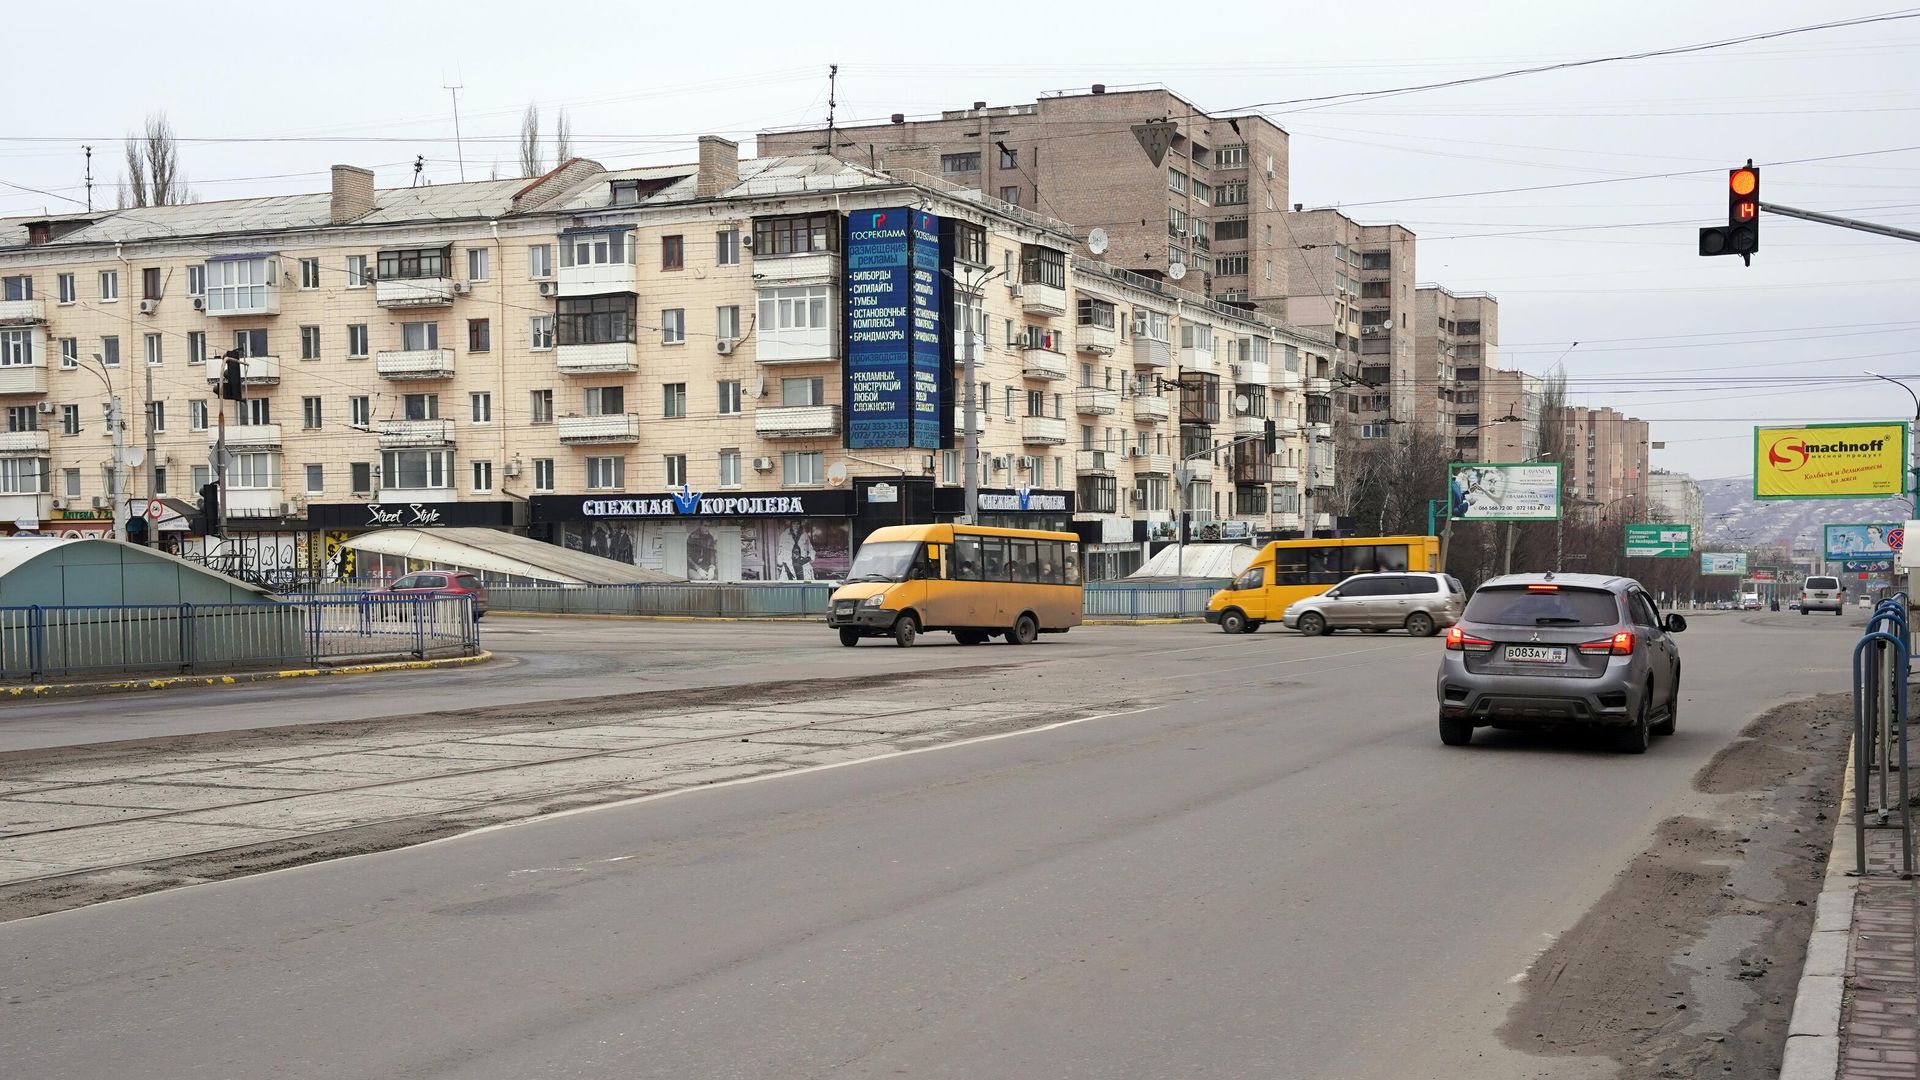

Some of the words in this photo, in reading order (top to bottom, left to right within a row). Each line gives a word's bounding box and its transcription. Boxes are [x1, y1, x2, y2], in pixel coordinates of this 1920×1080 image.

[1741, 203, 1753, 217] 14
[851, 229, 906, 240] ГОСРЕКЛАМА
[849, 243, 906, 258] размещение
[857, 254, 898, 268] рекламы
[853, 270, 891, 281] БИЛБОРДЫ
[853, 282, 893, 294] СИТИЛАЙТЫ
[854, 296, 878, 306] ТУМБЫ
[853, 307, 907, 319] ОСТАНОВОЧНЫЕ
[853, 318, 895, 329] КОМПЛЕКСЫ
[853, 330, 905, 342] БРАНДМАУЭРЫ
[854, 371, 895, 381] РЕКЛАМНЫХ
[853, 379, 901, 392] КОНСТРУКЦИЙ
[853, 390, 879, 402] ЛЮБОЙ
[853, 402, 895, 412] СЛОЖНОСТИ
[1769, 436, 1883, 472] Smachnoff
[1804, 470, 1833, 481] Колбасы
[1841, 463, 1883, 474] деликатесы
[1840, 475, 1857, 483] мяса
[582, 499, 675, 516] СНЕЖНАЯ
[700, 497, 804, 514] КОРОЛЕВА
[365, 504, 404, 525] Street
[407, 503, 440, 525] Style
[1508, 647, 1547, 658] В083АУ
